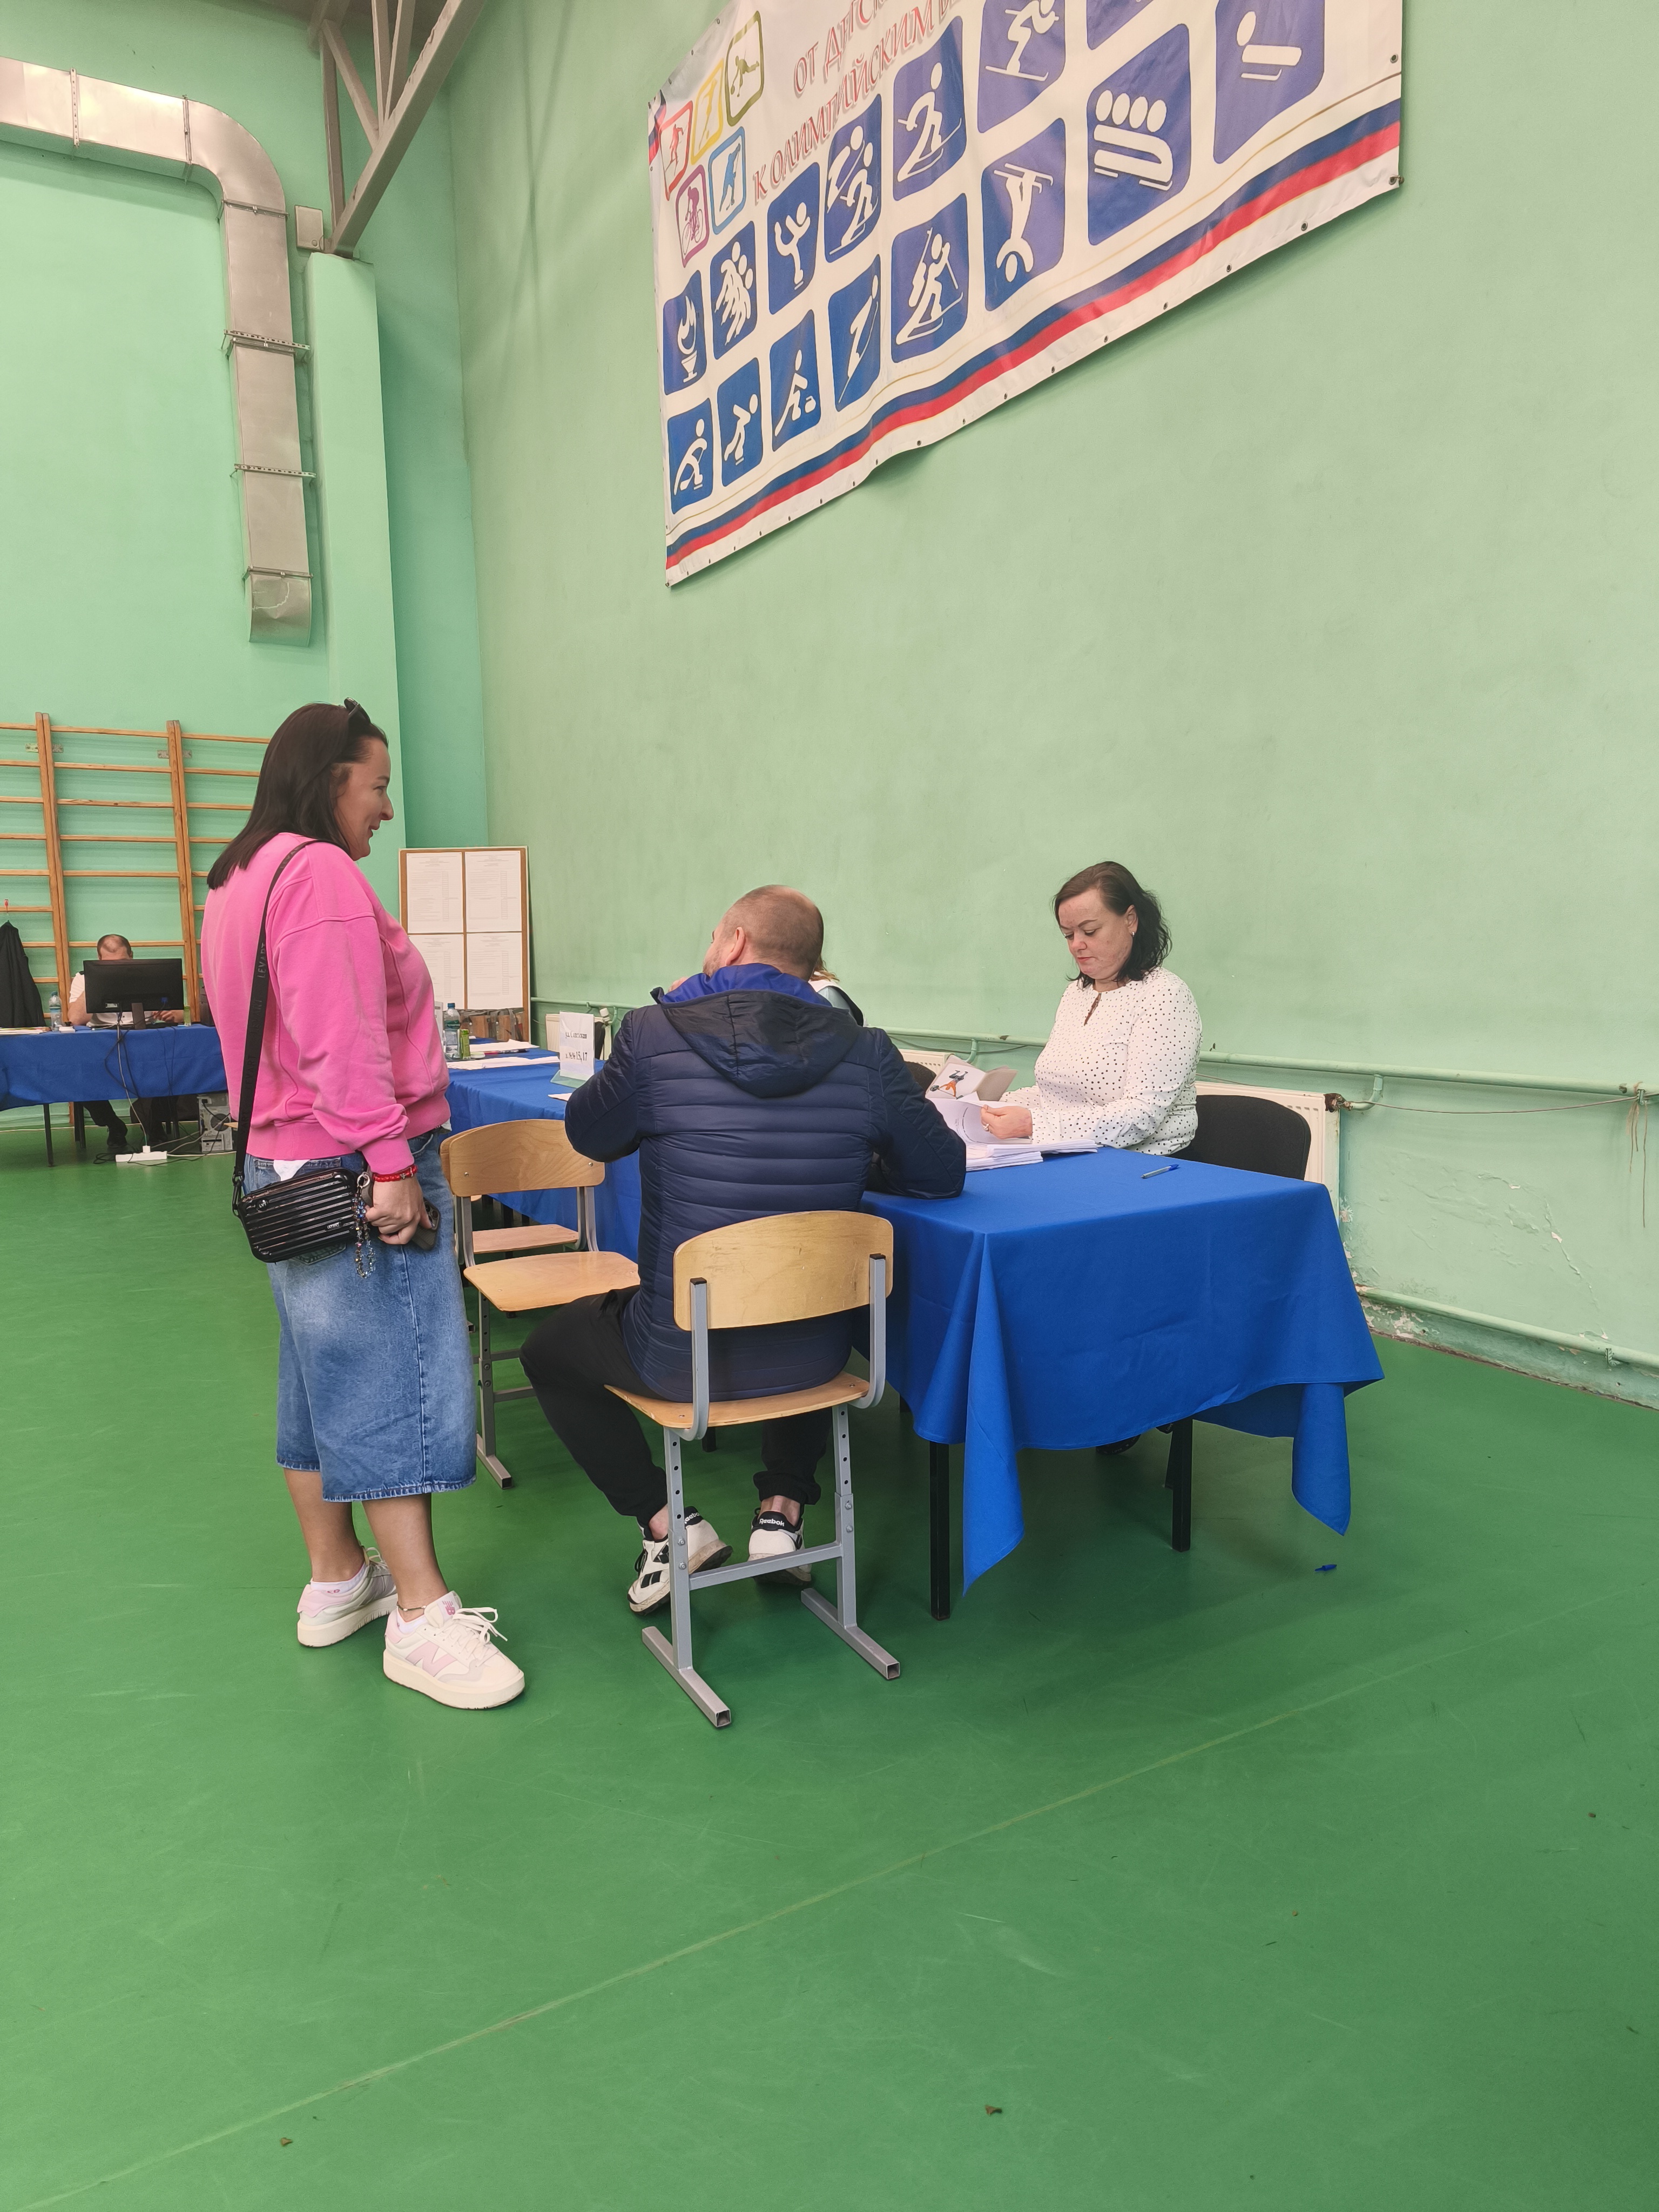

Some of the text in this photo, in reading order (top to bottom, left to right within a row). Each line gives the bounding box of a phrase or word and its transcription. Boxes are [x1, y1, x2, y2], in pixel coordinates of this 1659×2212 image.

[794, 41, 819, 92] ОТ
[754, 0, 935, 200] К ОЛИМПИЙСКИМ
[583, 1051, 588, 1061] 17
[684, 1512, 701, 1525] eebo
[759, 1518, 785, 1527] Reebok
